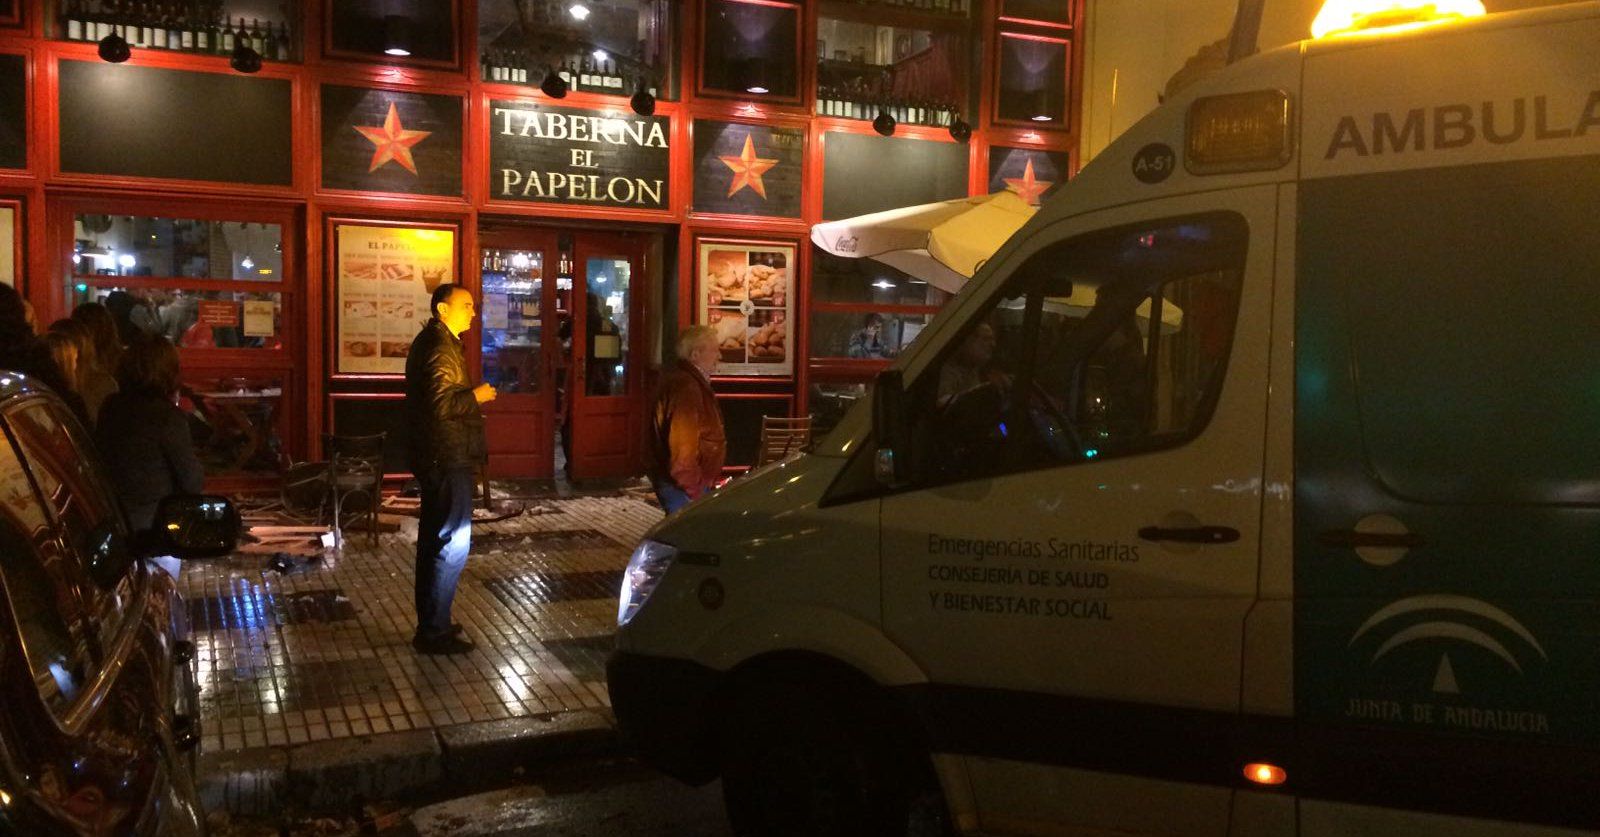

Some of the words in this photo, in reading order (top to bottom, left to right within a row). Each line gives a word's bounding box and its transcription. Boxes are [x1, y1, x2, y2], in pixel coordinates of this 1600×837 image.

[495, 107, 669, 148] TABERNA
[570, 148, 599, 168] EL
[1135, 155, 1172, 174] A-51
[501, 169, 664, 205] PAPELON
[368, 242, 379, 250] EL
[928, 533, 1041, 560] Emergencias
[1048, 538, 1140, 562] Sanitarias
[1028, 571, 1050, 586] DE
[1056, 572, 1109, 589] SALUD
[929, 593, 940, 608] Y
[944, 593, 1041, 616] BIENESTAR
[1046, 598, 1112, 621] SOCIAL
[1414, 705, 1434, 724] DE
